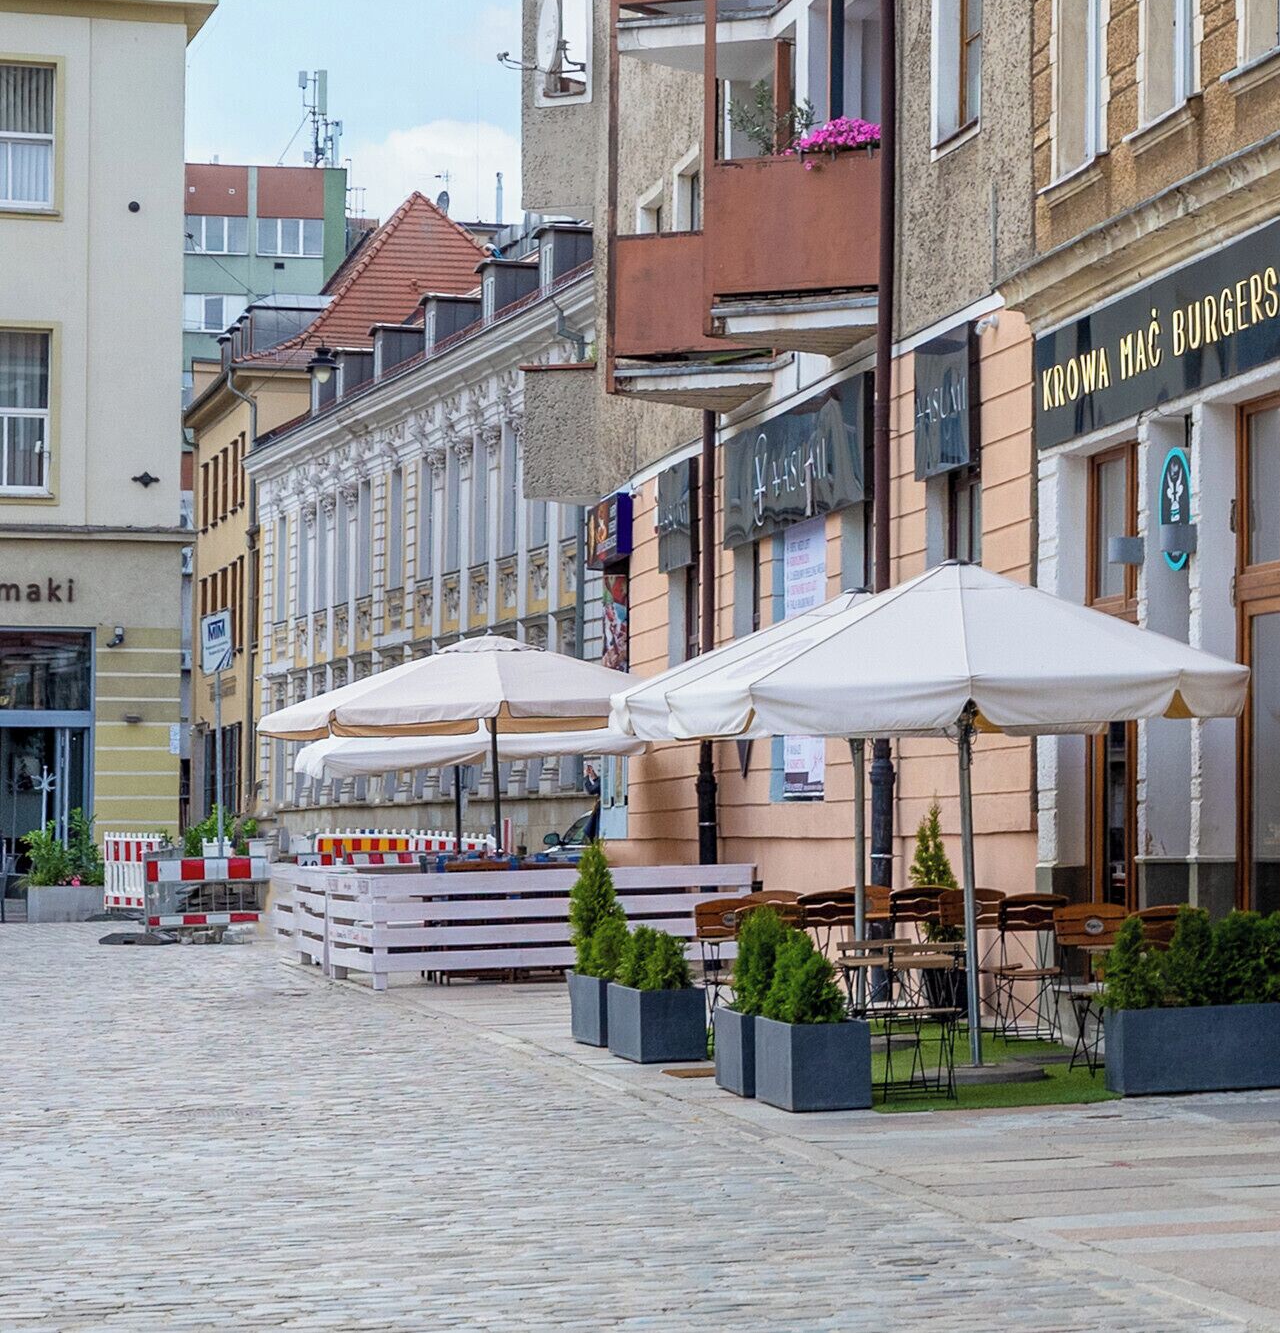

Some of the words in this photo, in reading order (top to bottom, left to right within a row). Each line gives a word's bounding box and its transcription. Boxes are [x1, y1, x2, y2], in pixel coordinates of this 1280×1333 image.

[1042, 347, 1111, 411] KROWA
[1119, 308, 1162, 380] MAĆ
[1172, 266, 1280, 357] BURGERS
